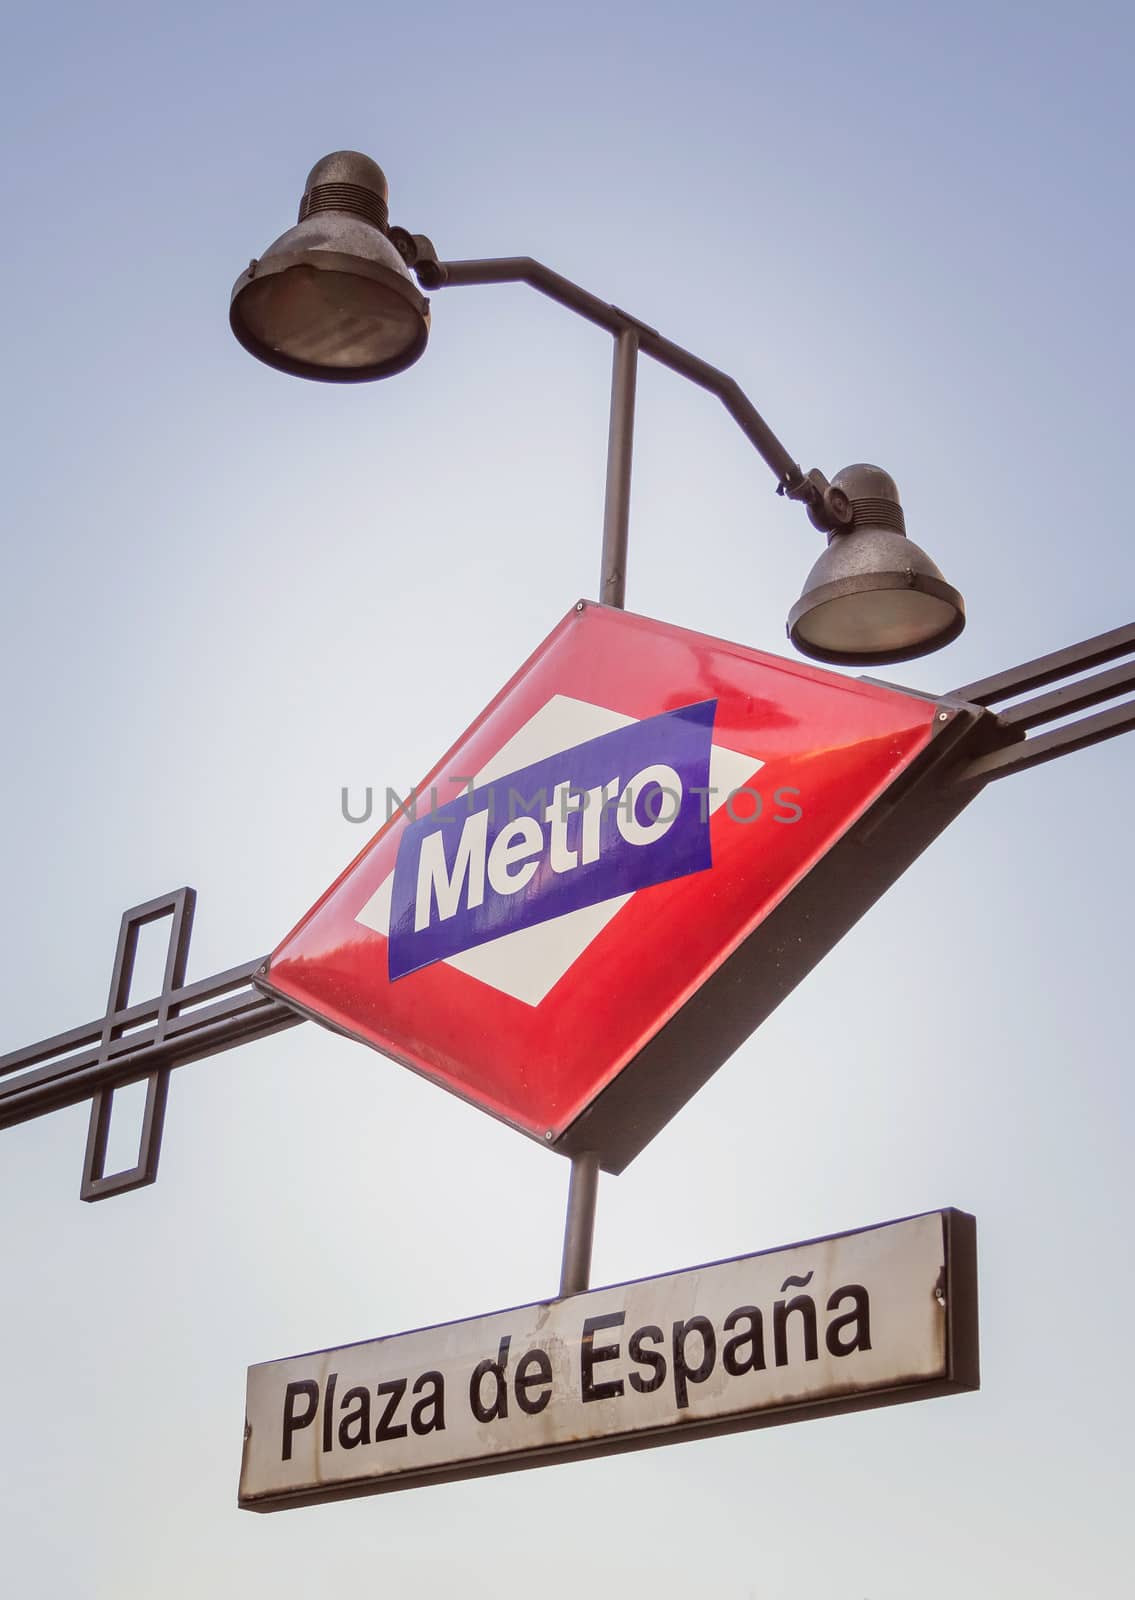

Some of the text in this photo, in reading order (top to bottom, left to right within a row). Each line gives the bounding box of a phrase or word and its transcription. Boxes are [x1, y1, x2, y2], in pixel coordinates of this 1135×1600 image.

[414, 764, 683, 932] Metro
[281, 1271, 872, 1460] Plaza de España
